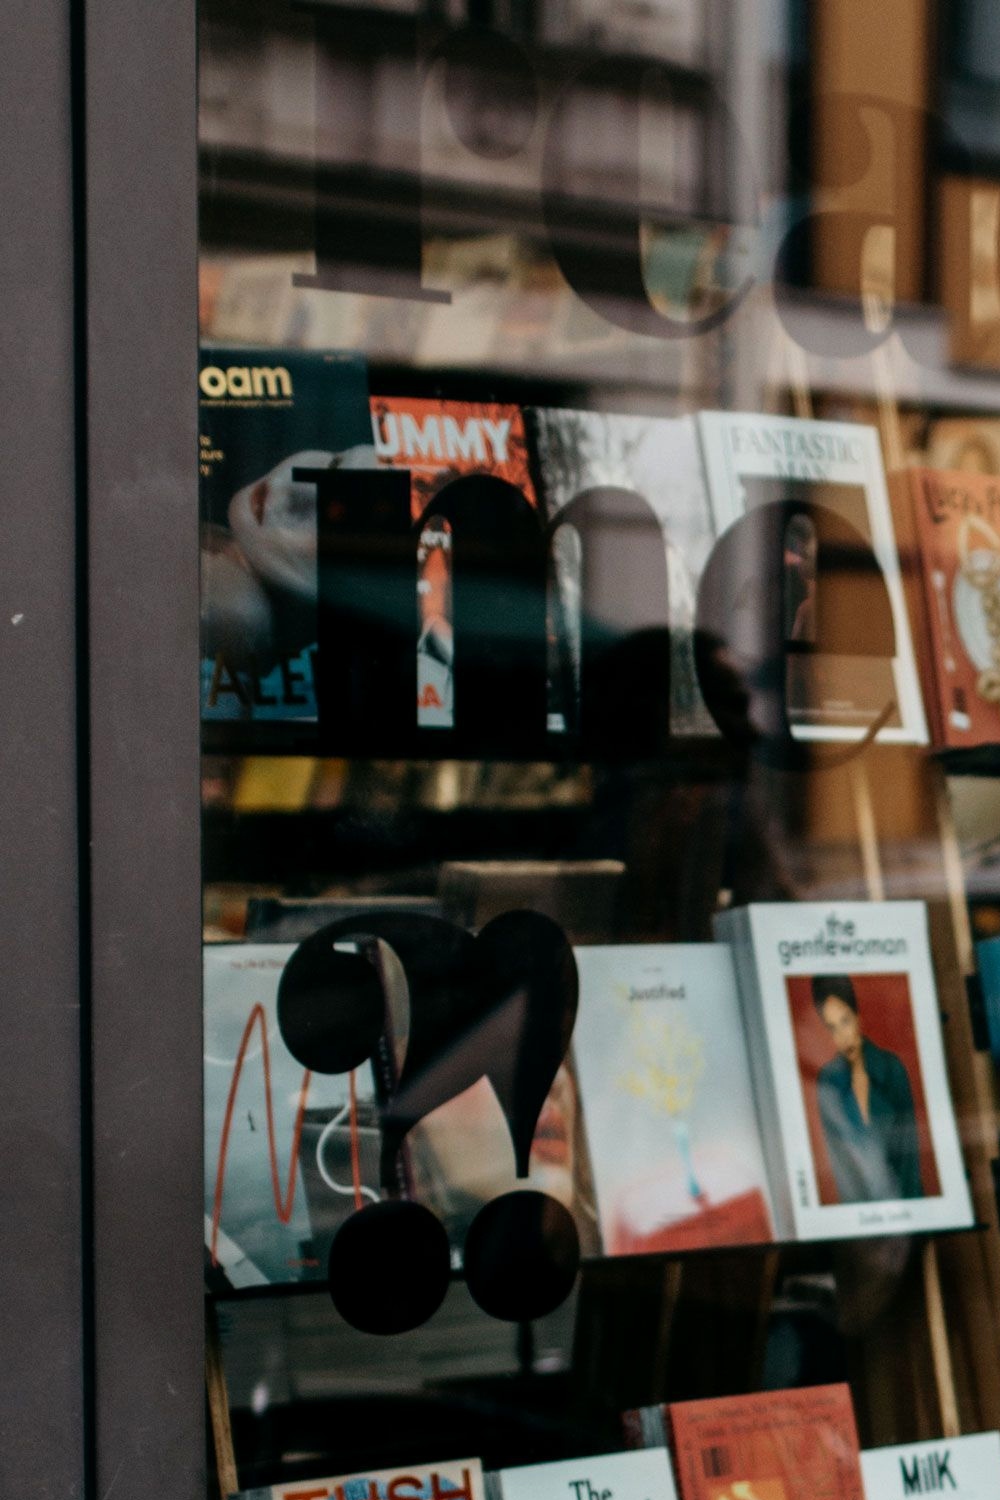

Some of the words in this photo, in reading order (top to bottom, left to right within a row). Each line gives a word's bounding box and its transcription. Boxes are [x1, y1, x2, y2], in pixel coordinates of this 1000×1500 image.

[199, 366, 291, 397] oam
[371, 412, 511, 463] UMMY
[826, 911, 855, 936] the
[778, 929, 908, 966] gentlewoman
